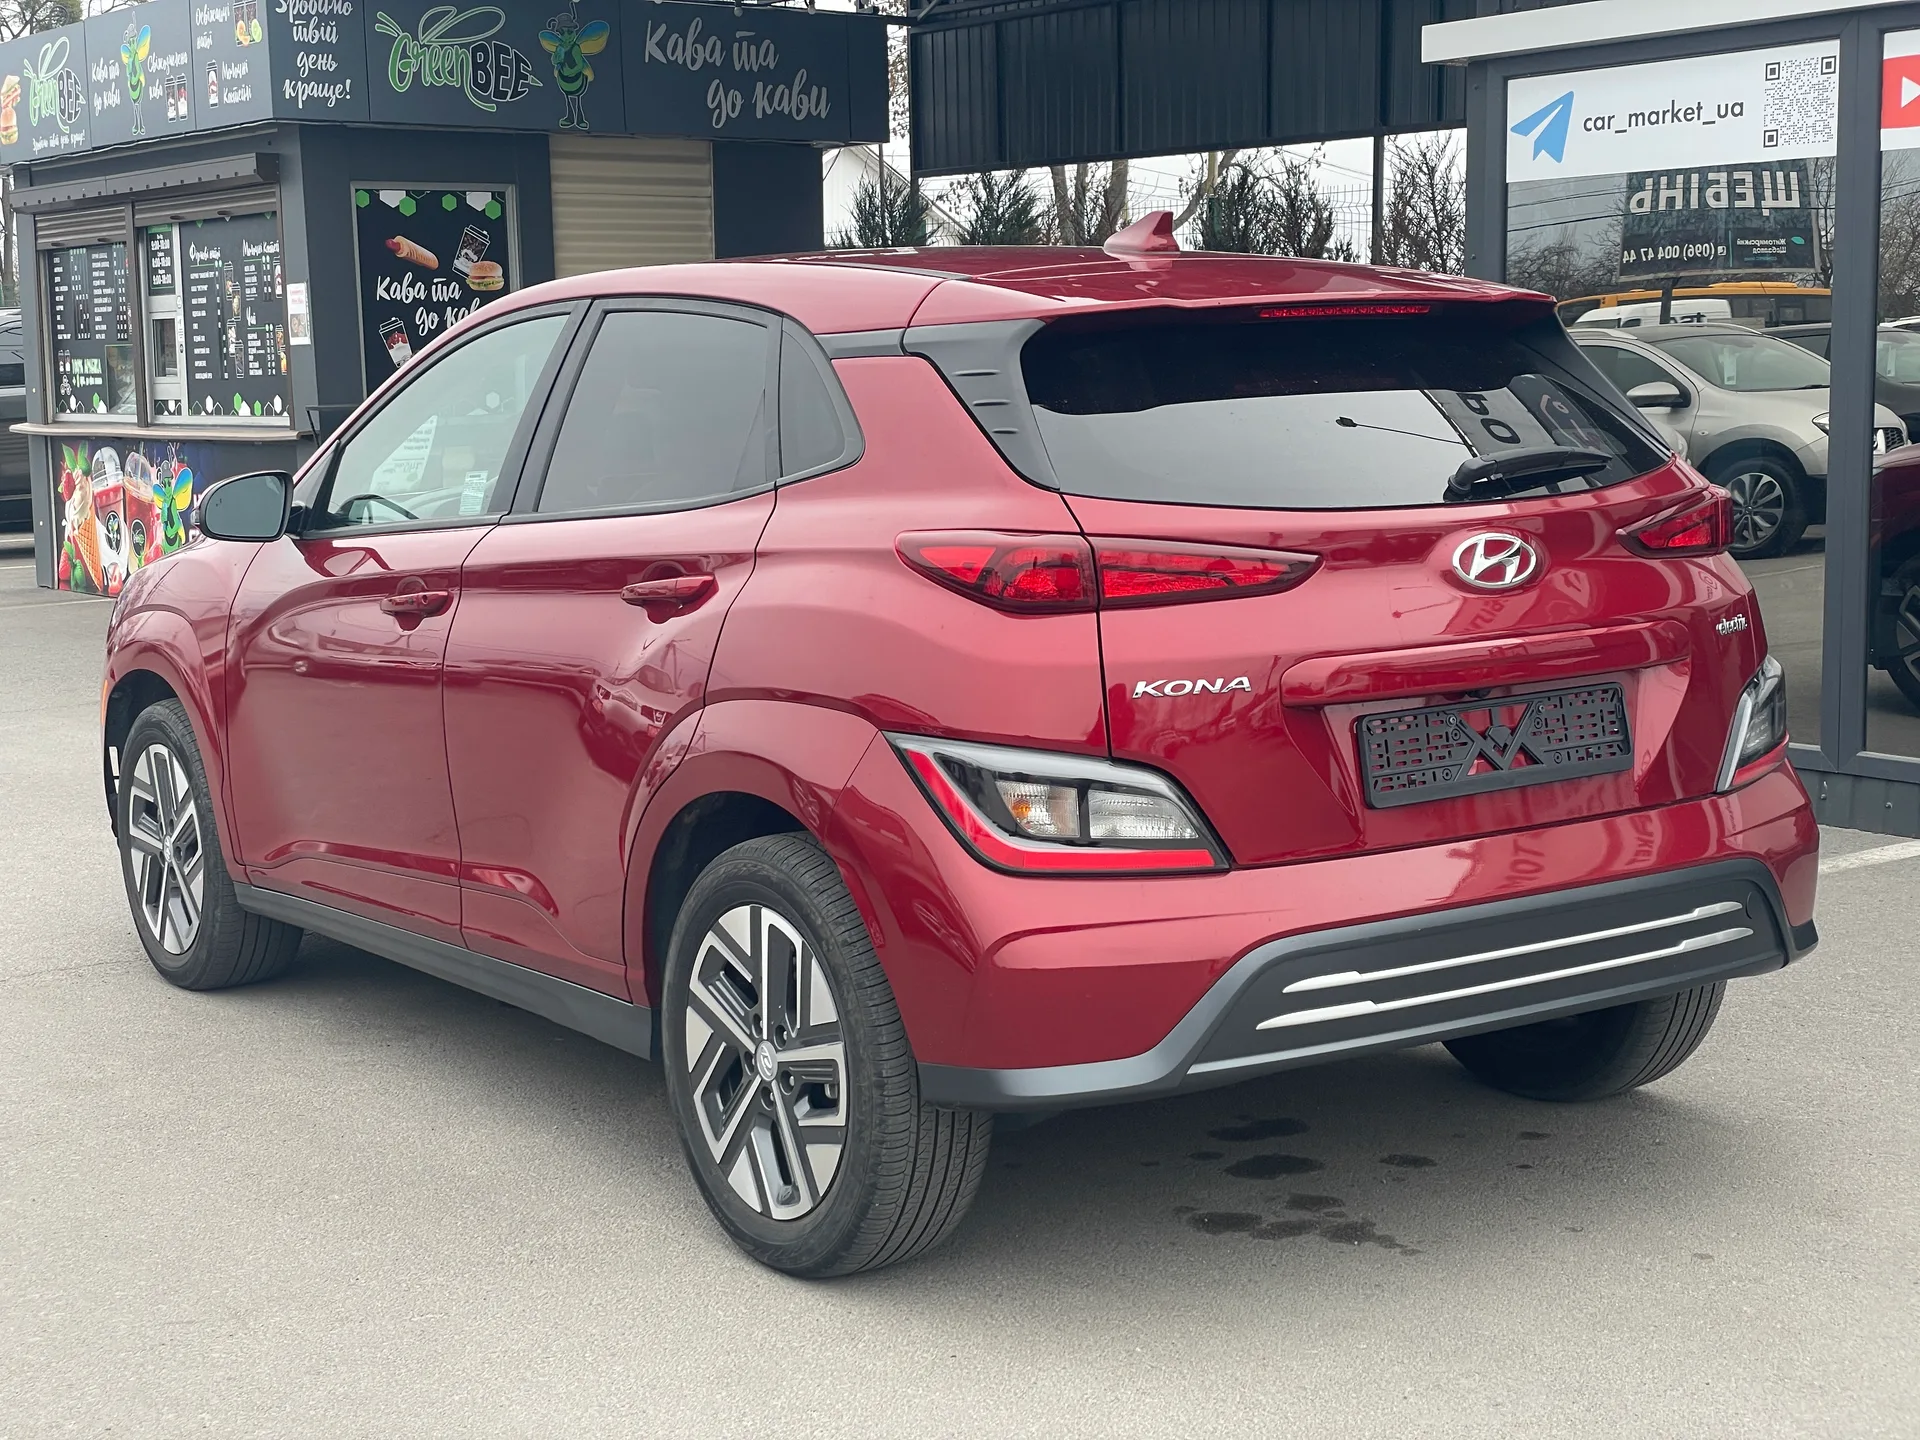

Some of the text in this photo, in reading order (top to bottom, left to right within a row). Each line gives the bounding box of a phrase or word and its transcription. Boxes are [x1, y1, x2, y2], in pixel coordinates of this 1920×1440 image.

[292, 16, 338, 44] твій
[645, 17, 779, 72] Кава та
[91, 57, 120, 83] Кава та
[296, 51, 338, 78] день
[103, 81, 121, 109] кави
[282, 78, 352, 109] краще!
[707, 68, 831, 129] до кави
[1583, 99, 1744, 135] car_market_ua
[376, 271, 463, 304] Кава та
[415, 306, 440, 337] до
[1132, 676, 1252, 699] KONA
